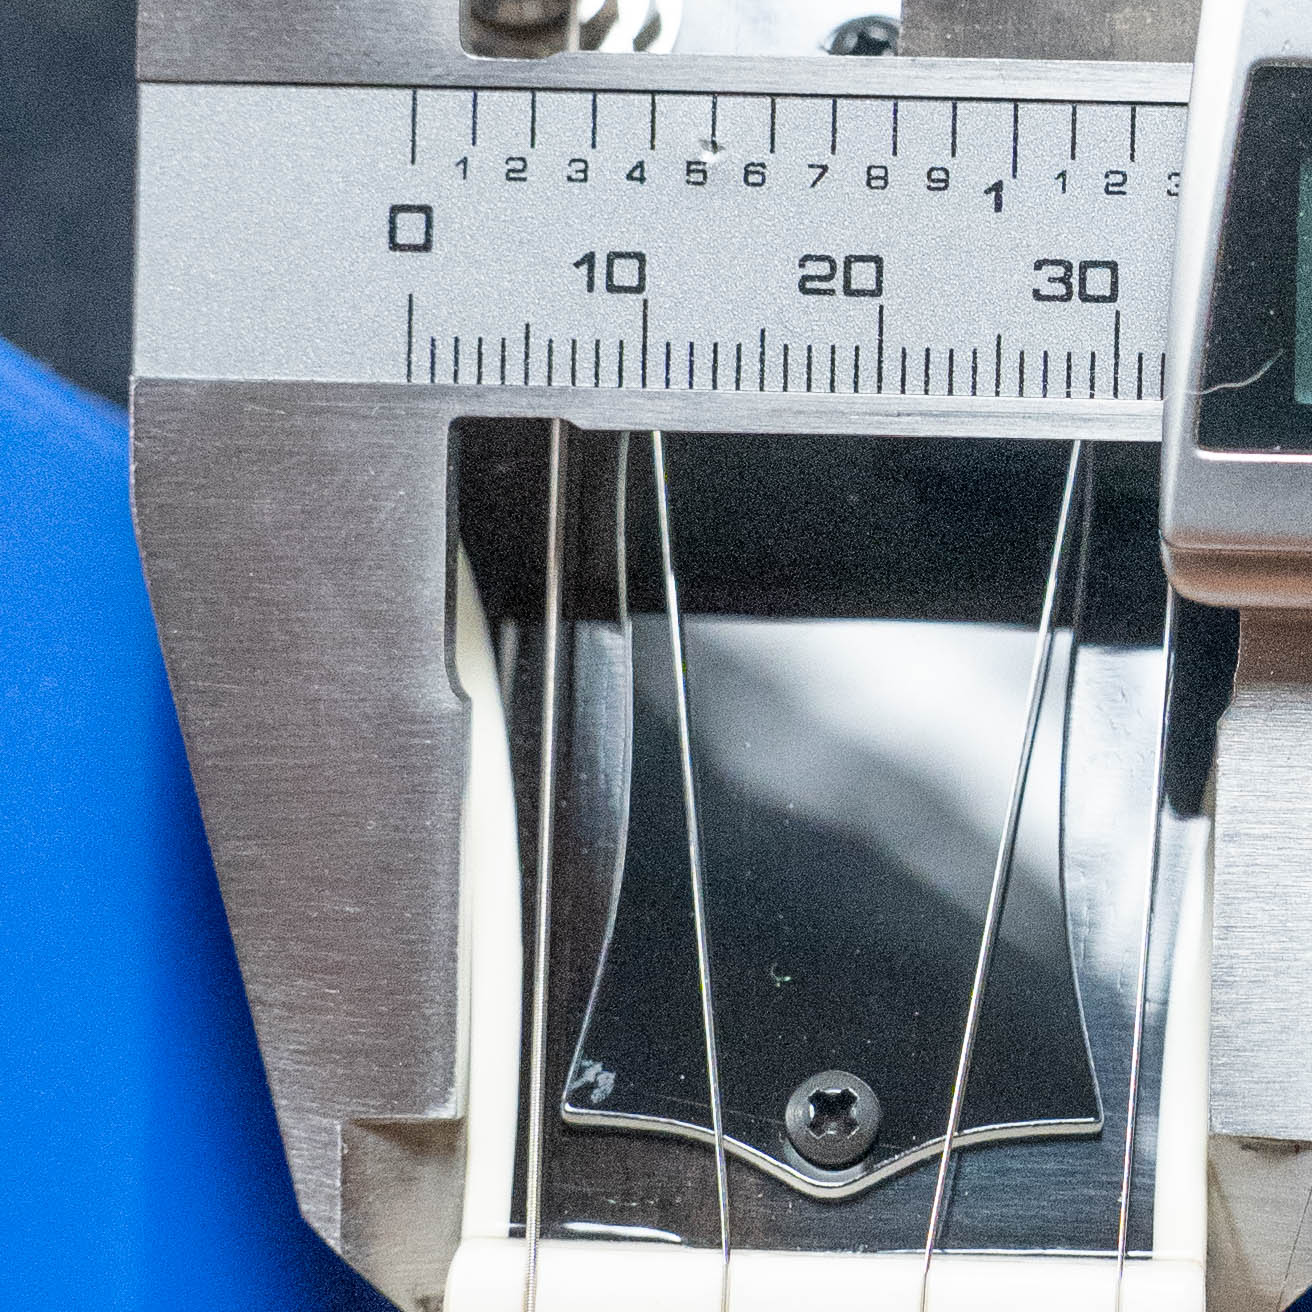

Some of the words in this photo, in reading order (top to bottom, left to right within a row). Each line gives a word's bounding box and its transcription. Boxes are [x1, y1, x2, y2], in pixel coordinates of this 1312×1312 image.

[454, 155, 470, 181] 1
[504, 156, 529, 183] 2
[566, 158, 591, 184] 3
[625, 159, 649, 185] 4
[685, 160, 710, 187] 5
[742, 161, 768, 189] 6
[806, 163, 830, 190] 7
[865, 164, 890, 191] 8
[925, 166, 951, 192] 9
[983, 179, 1004, 214] 1
[1054, 169, 1069, 195] 1
[1103, 170, 1128, 196] 2
[387, 203, 435, 254] 0
[572, 250, 649, 295] 10
[797, 253, 885, 298] 20
[1031, 257, 1121, 304] 30
